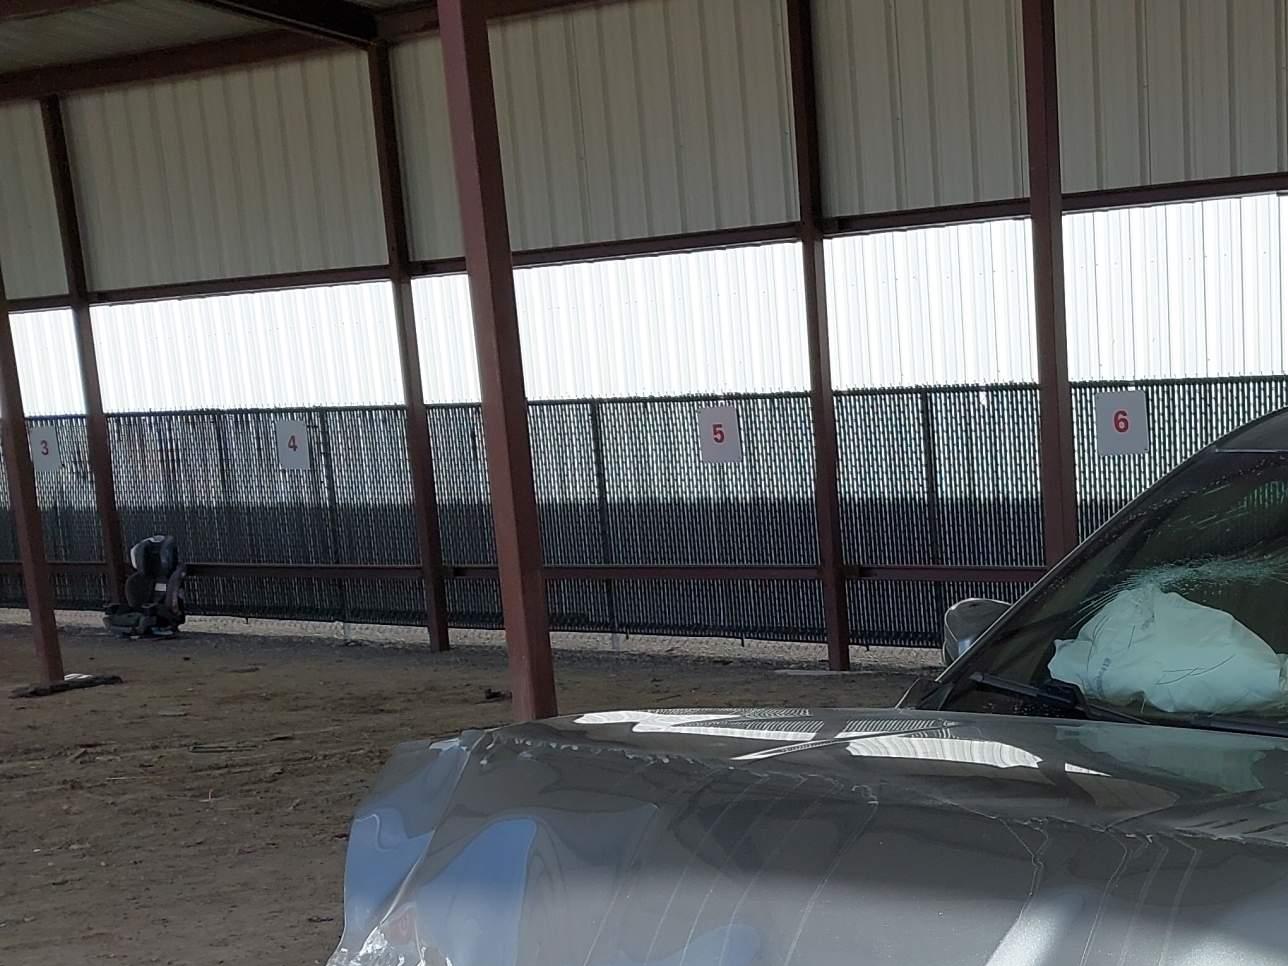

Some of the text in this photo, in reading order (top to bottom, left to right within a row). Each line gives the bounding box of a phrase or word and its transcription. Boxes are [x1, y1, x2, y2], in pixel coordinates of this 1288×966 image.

[1113, 409, 1129, 433] 6
[712, 423, 725, 443] 5
[40, 440, 49, 456] 3
[287, 435, 298, 452] 4
